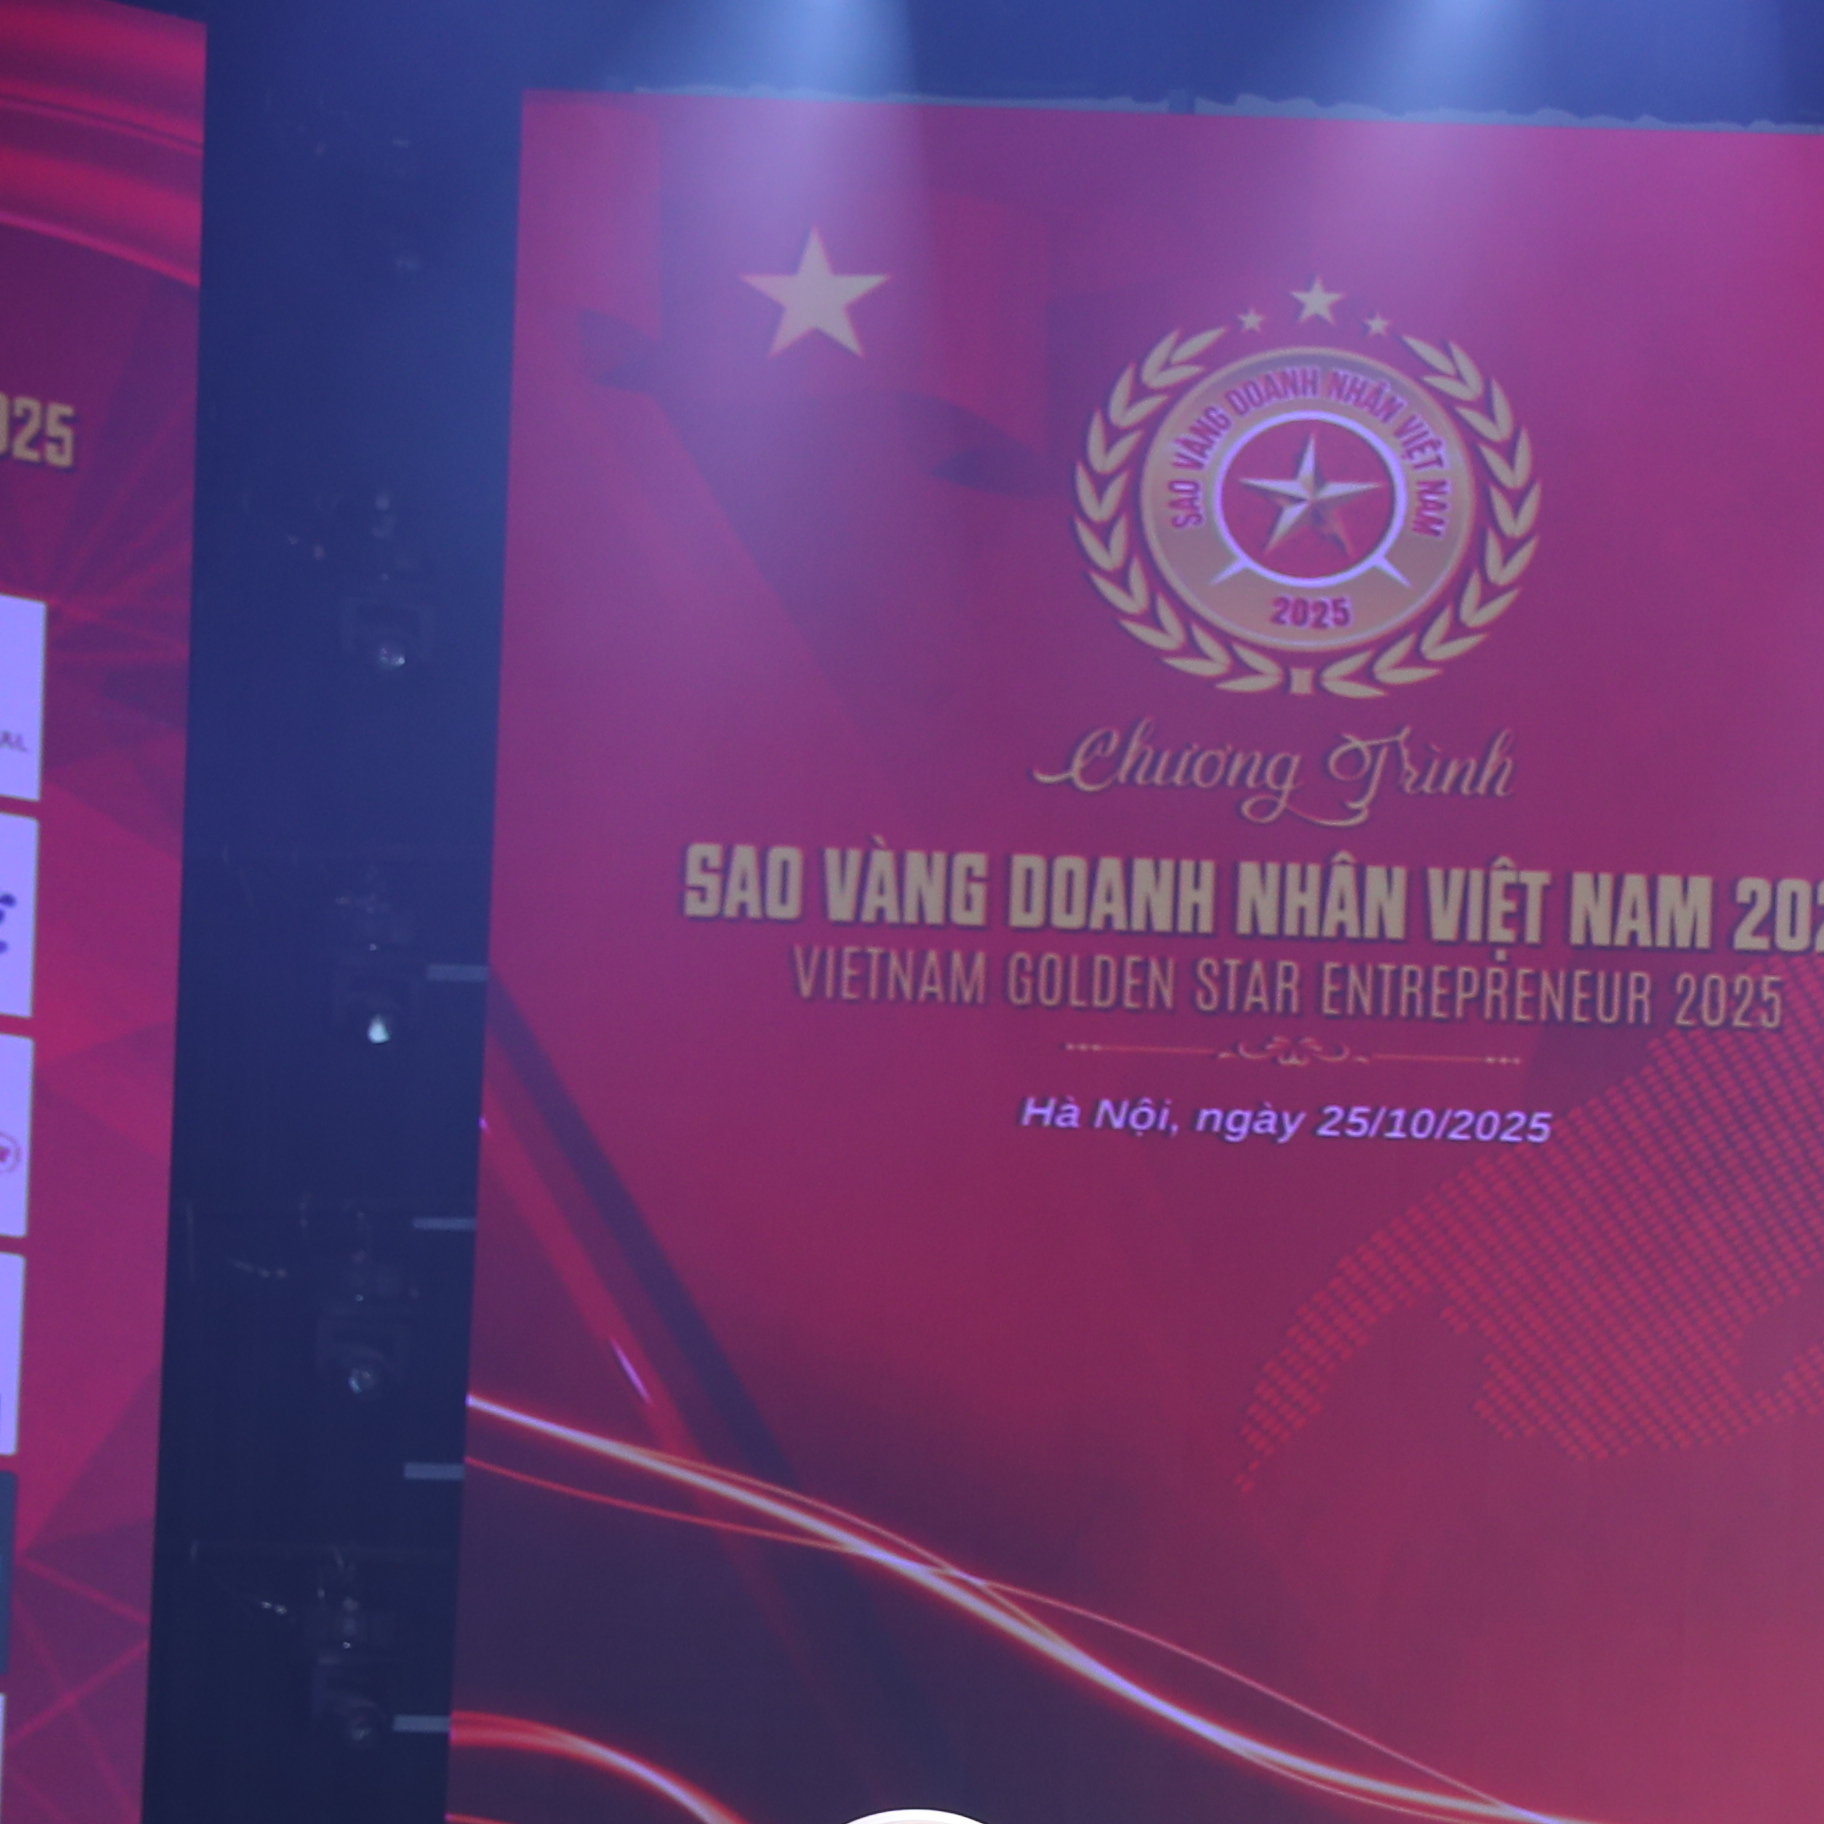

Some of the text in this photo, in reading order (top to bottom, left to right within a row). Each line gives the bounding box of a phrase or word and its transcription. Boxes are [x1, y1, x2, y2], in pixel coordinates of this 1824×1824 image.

[1169, 479, 1205, 530] SAO
[1224, 366, 1321, 416] DOANH
[1325, 367, 1407, 424] NHÂN
[1411, 479, 1451, 538] NAM
[1269, 594, 1352, 630] 2025
[1032, 715, 1516, 826] Chương Trình
[684, 843, 803, 920] SAO
[824, 834, 989, 927] VÀNG
[1008, 852, 1216, 935] DOANH
[1235, 851, 1406, 941] NHÂN
[1427, 856, 1551, 962] VIỆT
[1569, 871, 1713, 950] NAM
[794, 944, 1783, 1029] VIETNAM GOLDEN STAR ENTREPRENEUR 2025
[1021, 1096, 1552, 1143] Hà Nội, ngày 25/10/2025
